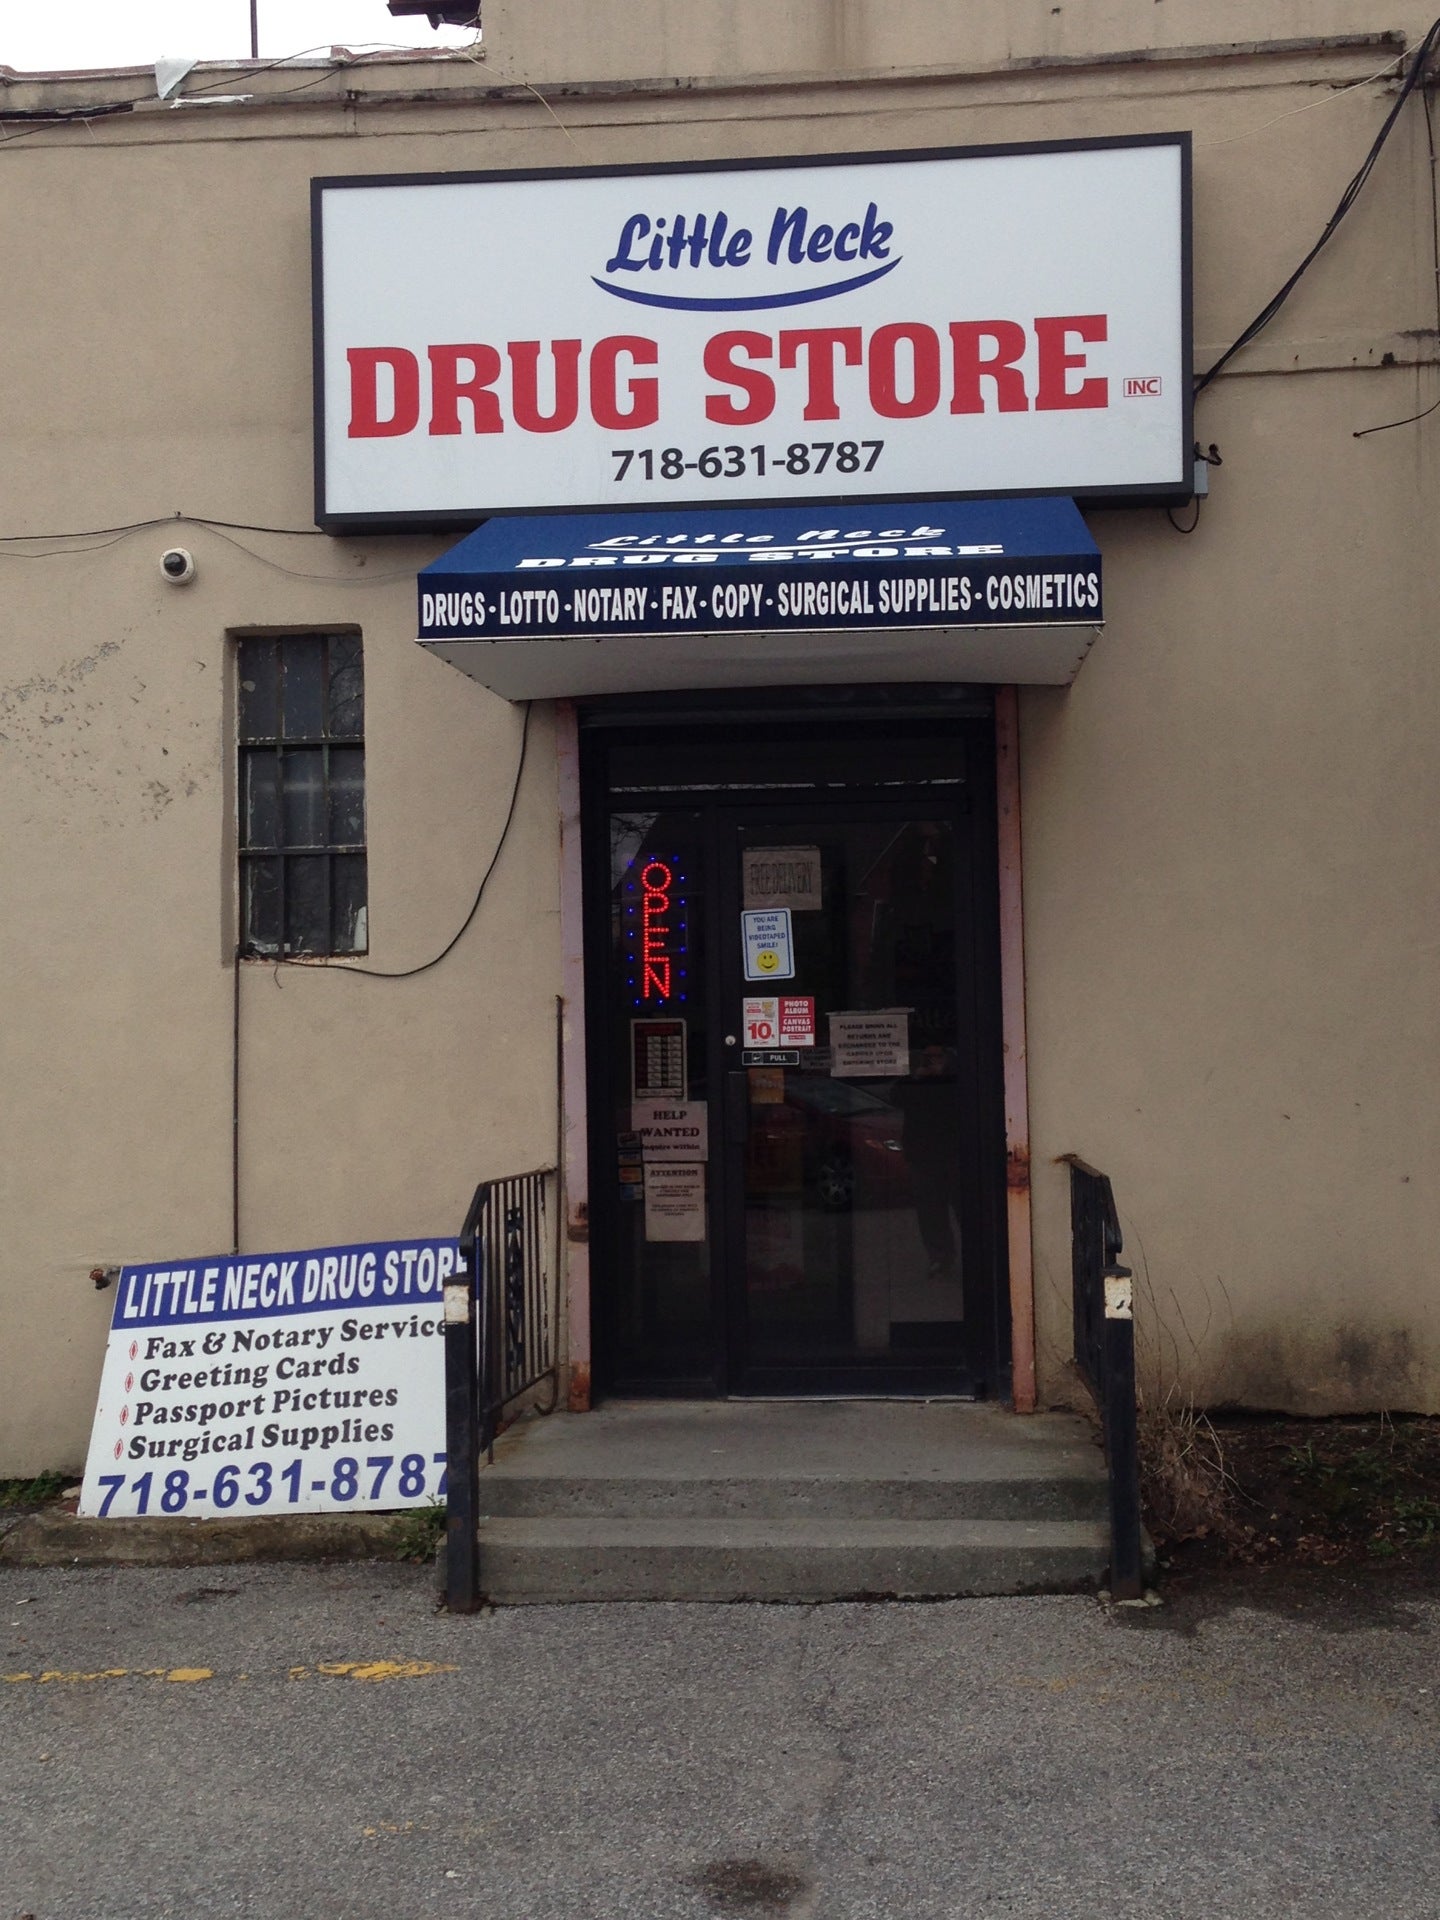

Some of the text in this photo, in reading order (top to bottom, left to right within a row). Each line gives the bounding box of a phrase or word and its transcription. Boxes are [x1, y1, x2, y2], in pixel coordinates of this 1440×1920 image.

[605, 202, 896, 273] Little Neck
[346, 314, 1109, 438] DRUG STORE
[1127, 379, 1158, 395] INC
[611, 440, 885, 482] 718-631-8787
[515, 544, 1004, 568] DRUG STORE
[588, 526, 946, 547] Little Neck
[422, 572, 1099, 627] DRUGS LOTTO NOTARY FAX COPY SURGICAL SUPPLIES COSMETICS
[641, 861, 671, 998] OPEN
[770, 1054, 786, 1062] PULL
[640, 1127, 700, 1137] WANTED
[653, 1111, 687, 1120] HELP
[650, 1169, 698, 1177] ATTENTION
[123, 1266, 218, 1319] LITTLE
[221, 1261, 300, 1312] NECK
[301, 1254, 376, 1304] DRUG
[143, 1336, 194, 1360] Fax
[201, 1332, 228, 1355] &
[231, 1326, 334, 1354] Notary
[139, 1352, 361, 1393] Greeting Cards
[133, 1386, 399, 1426] Passport Pictures
[127, 1417, 395, 1462] Surgical Supplies
